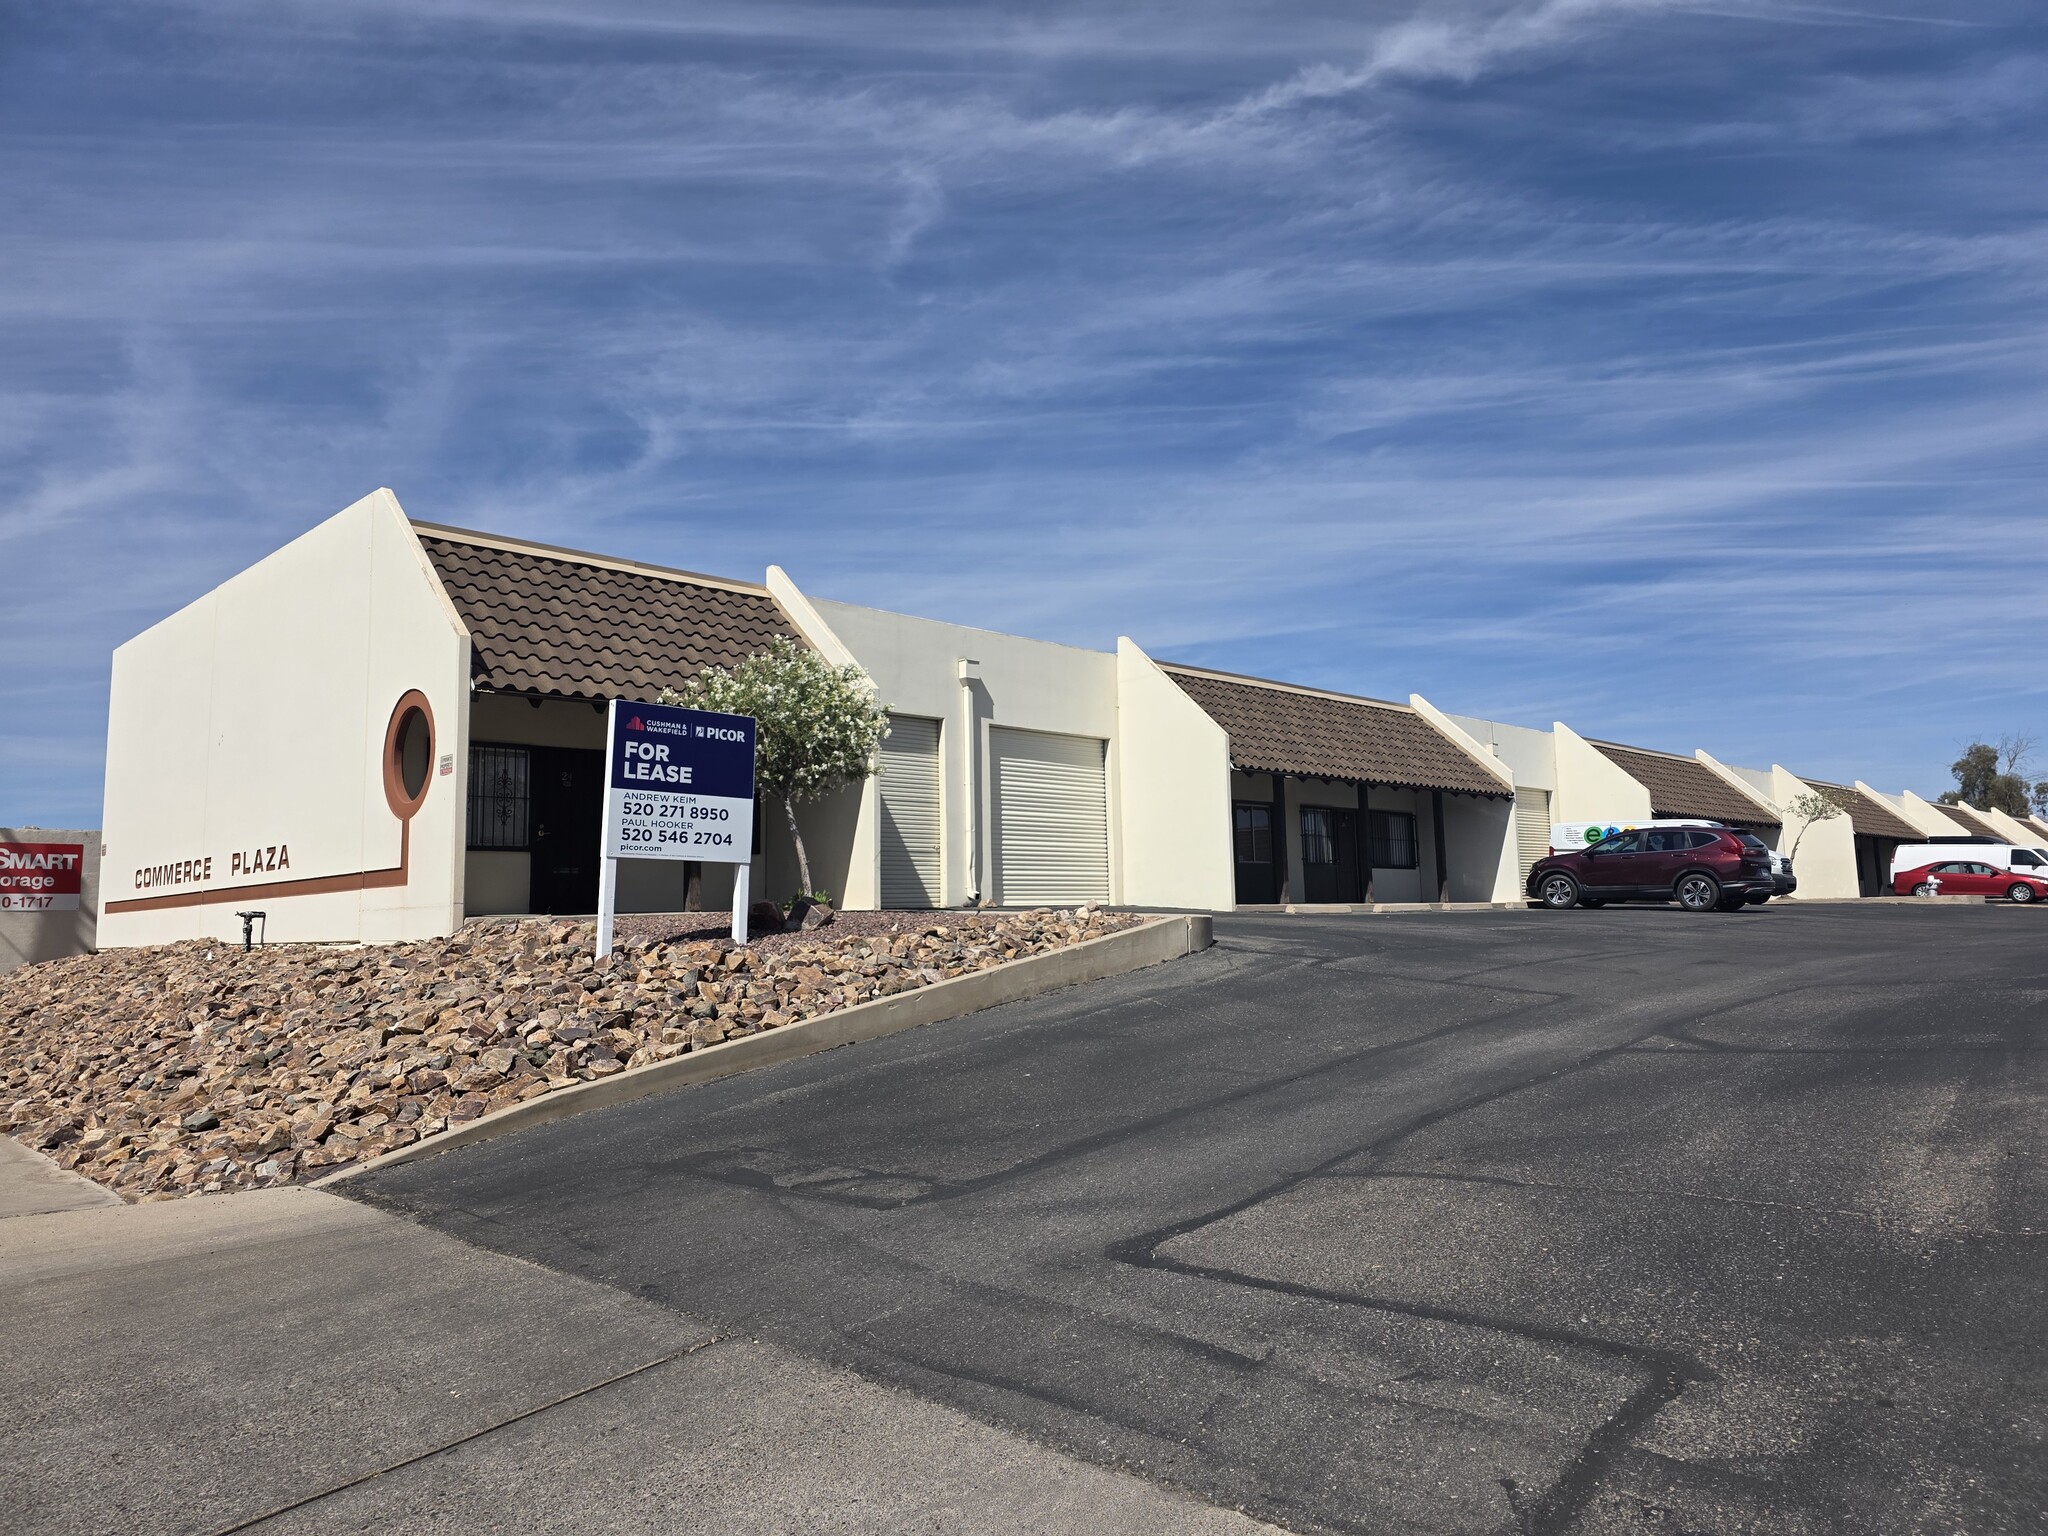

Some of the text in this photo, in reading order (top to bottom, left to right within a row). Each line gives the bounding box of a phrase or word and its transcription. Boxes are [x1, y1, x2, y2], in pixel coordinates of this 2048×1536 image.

[646, 719, 681, 730] CUSHMAN
[646, 726, 688, 736] WAKEFIELD
[706, 727, 746, 743] PICOR
[624, 741, 670, 762] FOR
[623, 762, 693, 784] LEASE
[623, 792, 697, 804] ANDREW KEIM
[622, 802, 729, 821] 520 271 8950
[621, 818, 694, 830] PAUL HOOKER
[621, 828, 733, 846] 520 546 2704
[620, 843, 662, 852] picor.com
[135, 844, 290, 889] COMMERCE PLAZA
